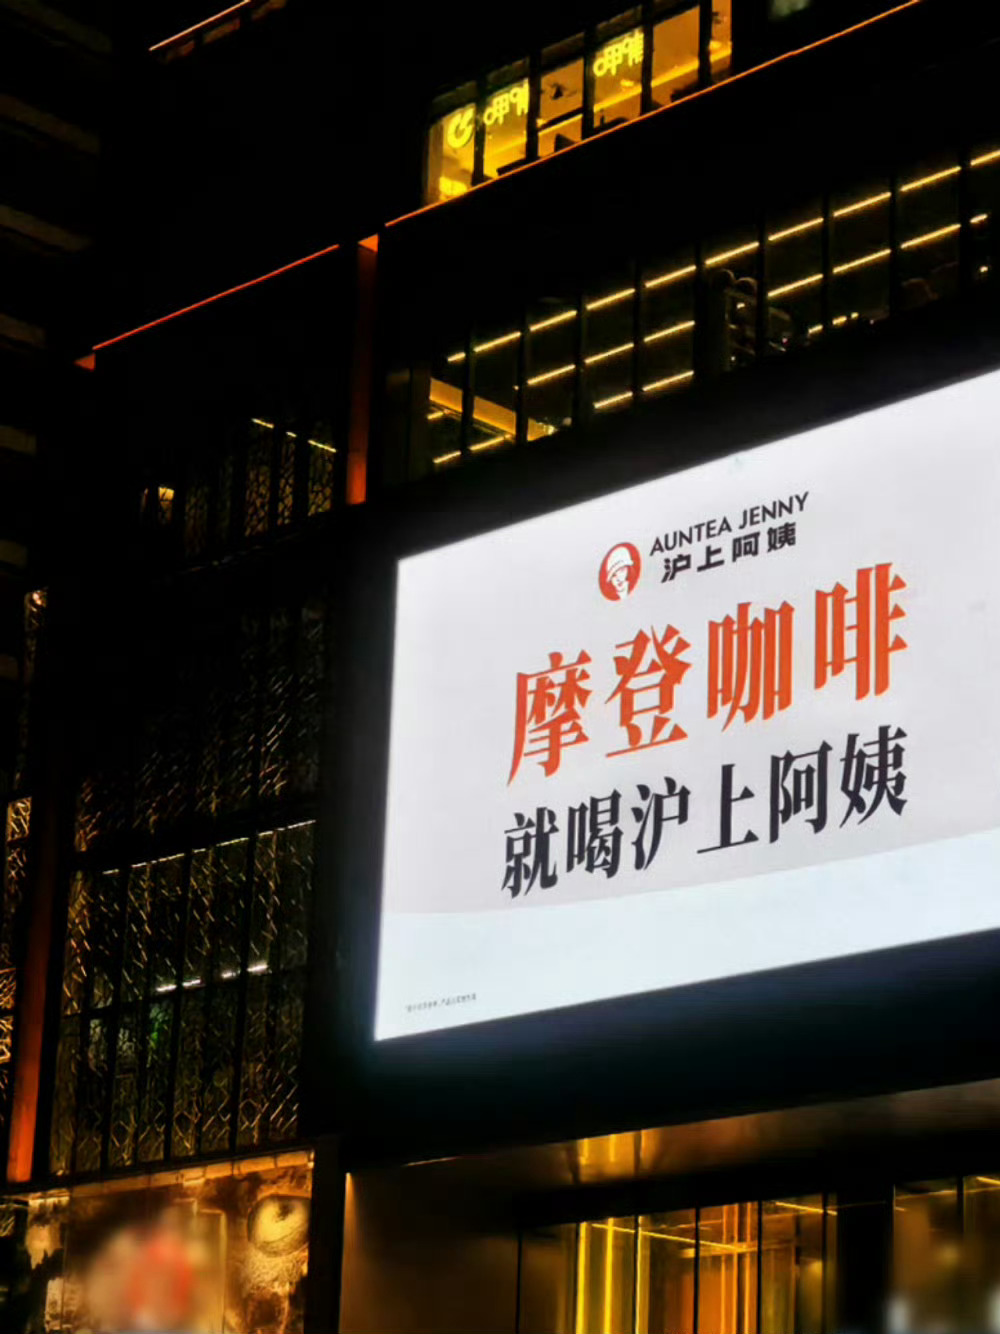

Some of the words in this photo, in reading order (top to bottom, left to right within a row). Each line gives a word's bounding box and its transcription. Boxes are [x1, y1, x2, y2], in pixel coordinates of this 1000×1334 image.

[650, 516, 732, 556] AUNTEA
[738, 491, 809, 530] JENNY
[661, 522, 796, 583] 沪上阿姨
[507, 562, 908, 787] 摩登咖啡
[501, 725, 908, 899] 就喝沪上阿姨
